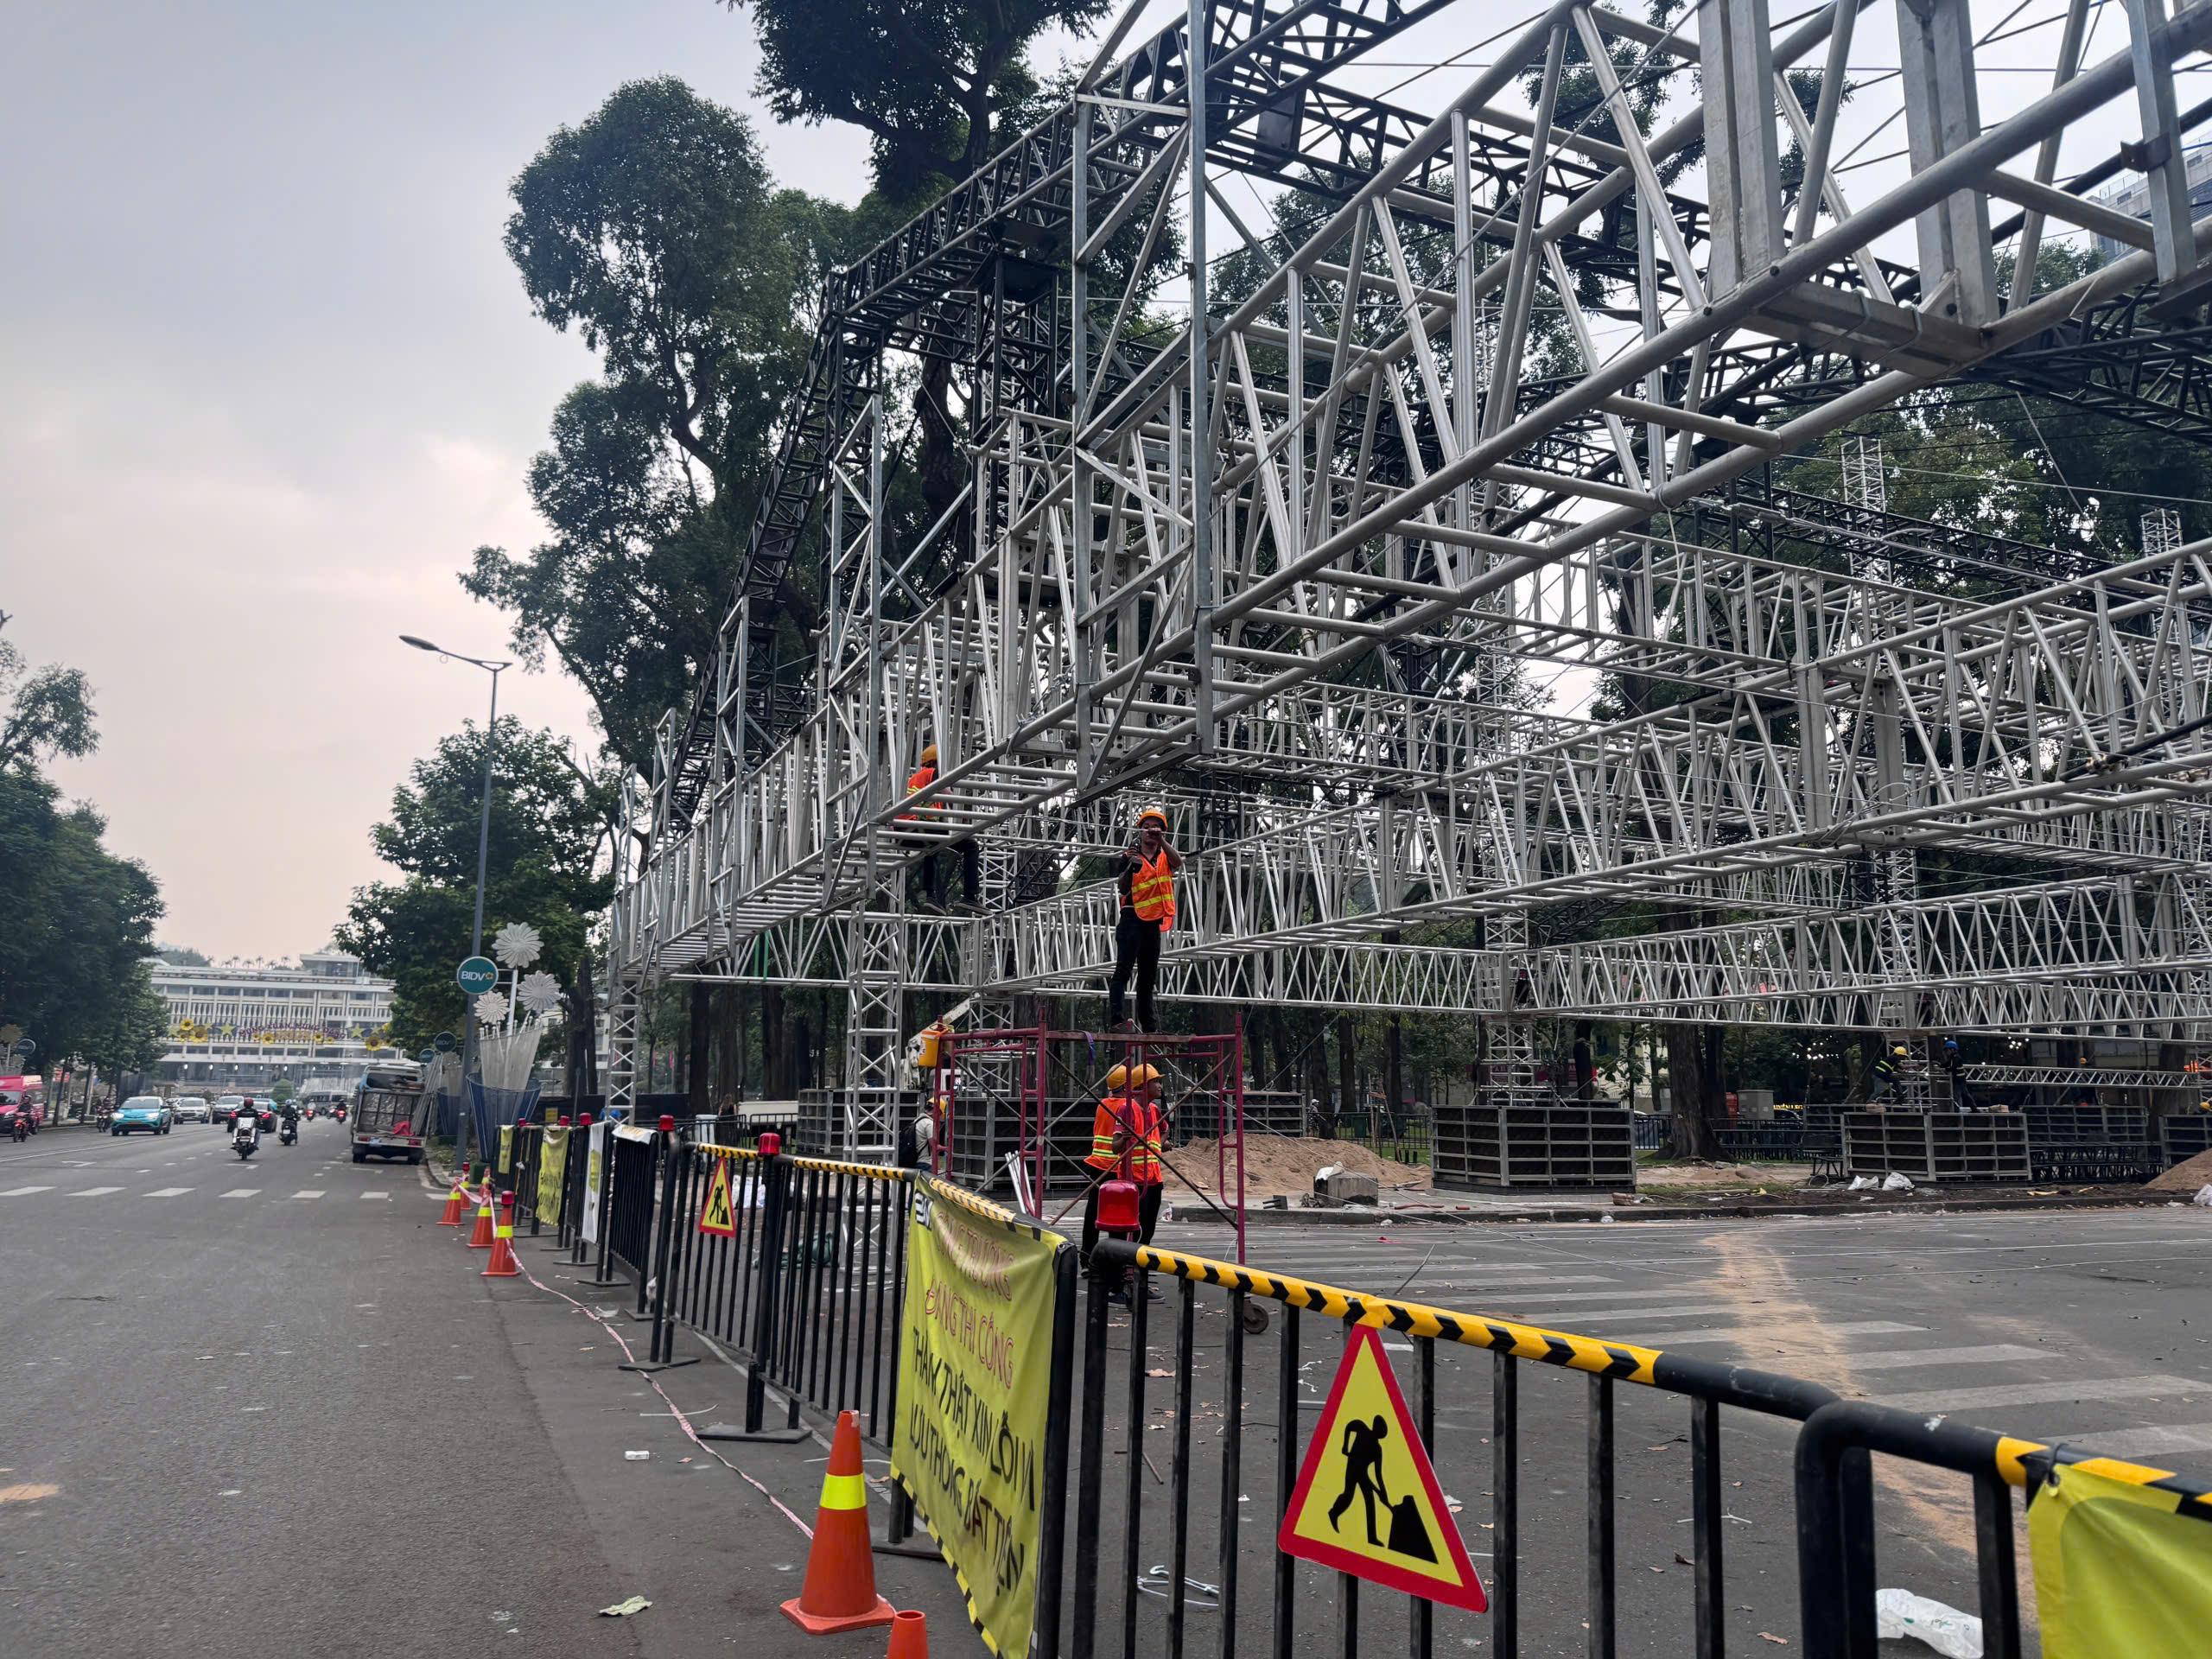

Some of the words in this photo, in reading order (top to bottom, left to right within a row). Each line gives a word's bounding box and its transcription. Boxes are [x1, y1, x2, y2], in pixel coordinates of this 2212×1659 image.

[461, 970, 486, 982] BIDV
[959, 1296, 977, 1355] THI
[978, 1312, 1014, 1389] CÔNG
[971, 1393, 994, 1459] XIN
